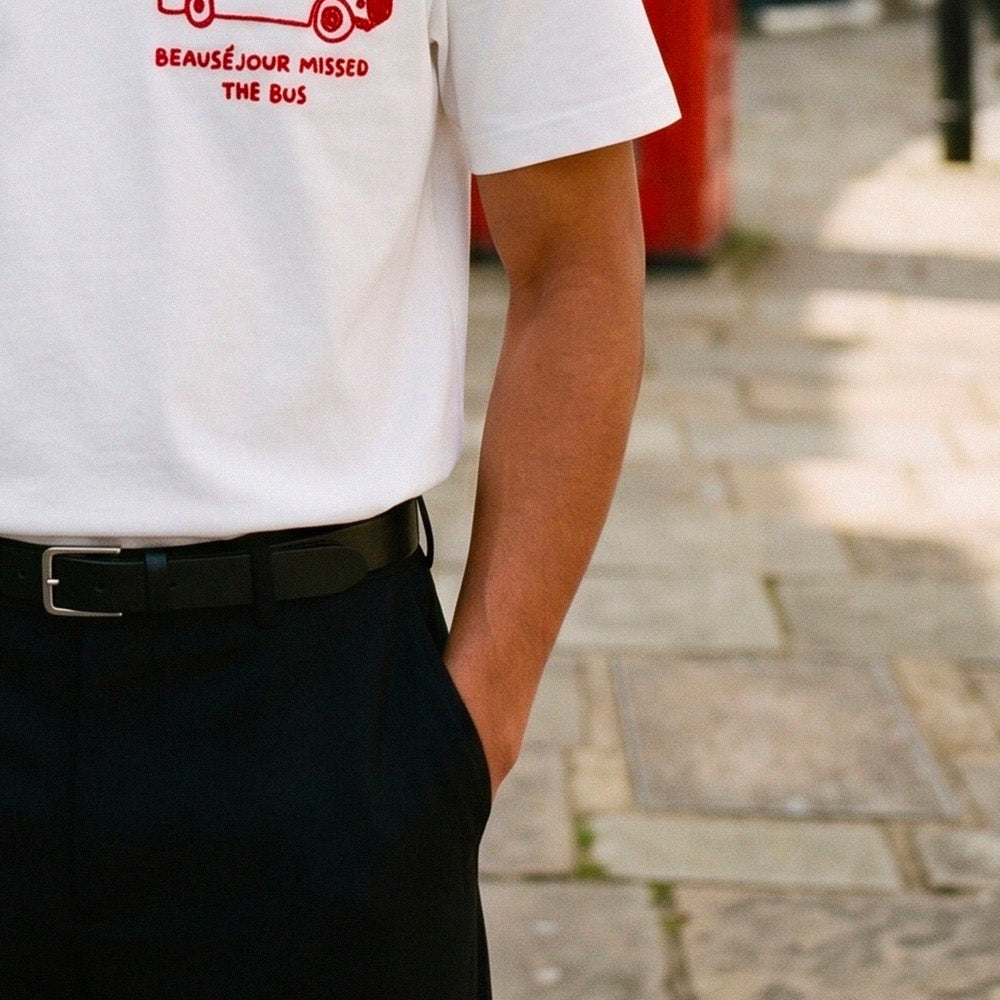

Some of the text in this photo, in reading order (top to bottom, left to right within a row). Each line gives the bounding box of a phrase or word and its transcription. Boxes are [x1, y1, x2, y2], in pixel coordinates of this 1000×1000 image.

[155, 44, 369, 78] BEAUSÉJOUR MISSED
[222, 81, 307, 105] THE BUS
